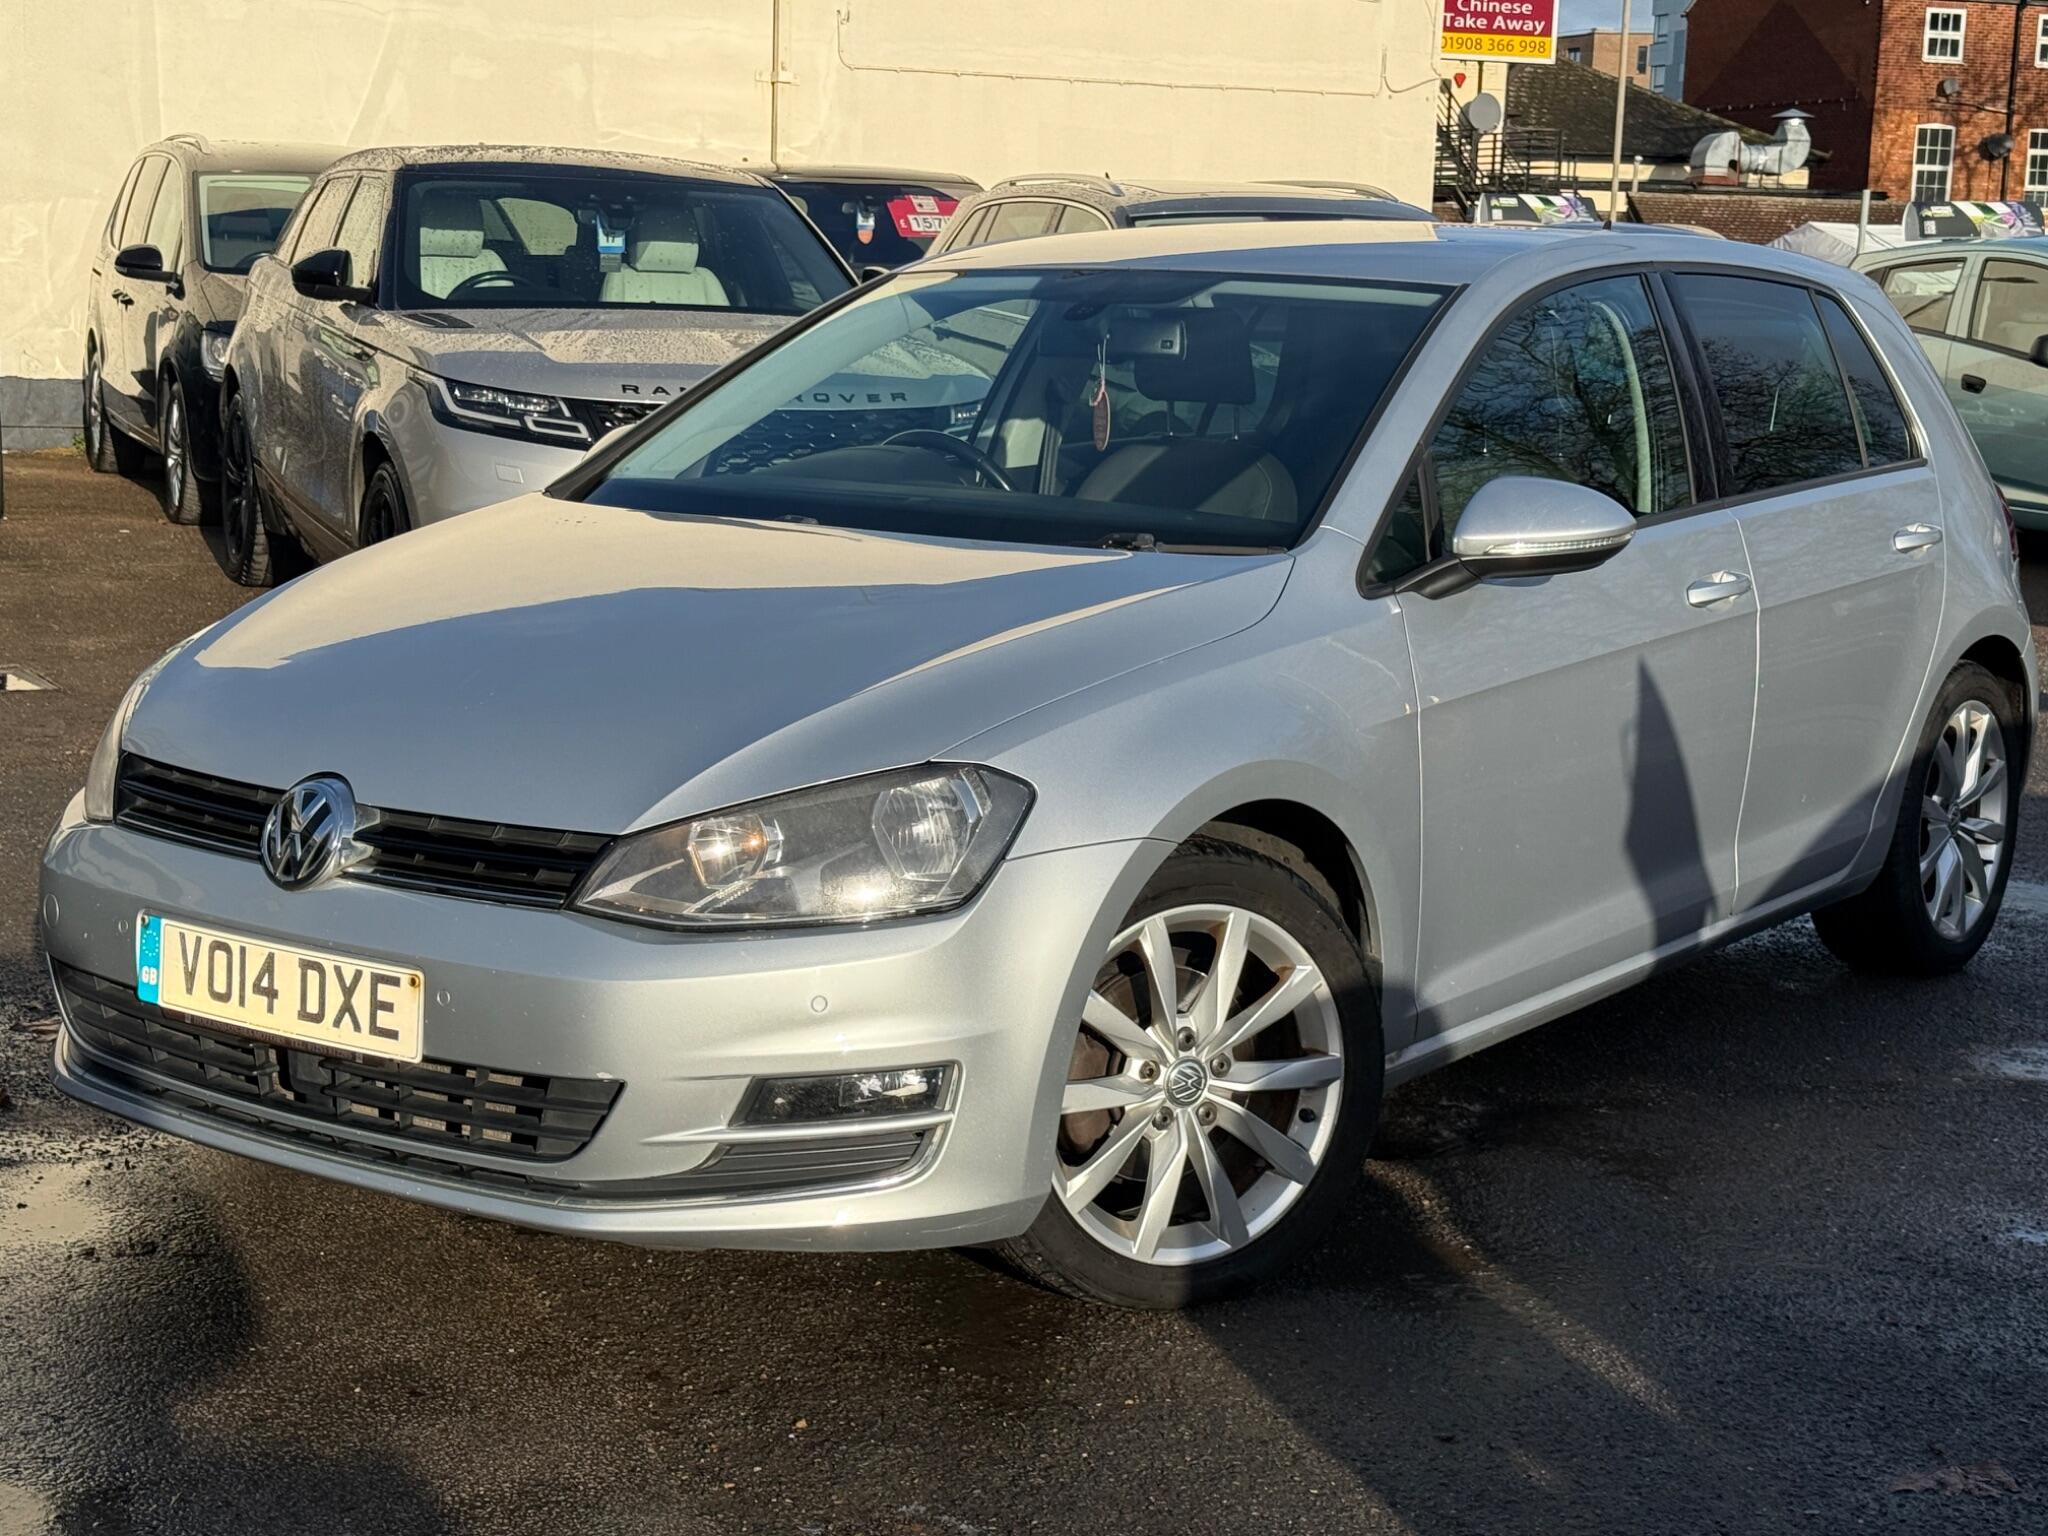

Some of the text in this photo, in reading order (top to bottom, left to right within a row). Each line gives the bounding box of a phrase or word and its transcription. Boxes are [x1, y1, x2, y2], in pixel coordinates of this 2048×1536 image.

[1457, 0, 1533, 14] Chinese
[1442, 12, 1545, 35] Take Away
[1441, 35, 1546, 54] 01908 366 998
[621, 384, 687, 396] RA
[141, 965, 157, 985] GB
[297, 957, 401, 1041] DXE
